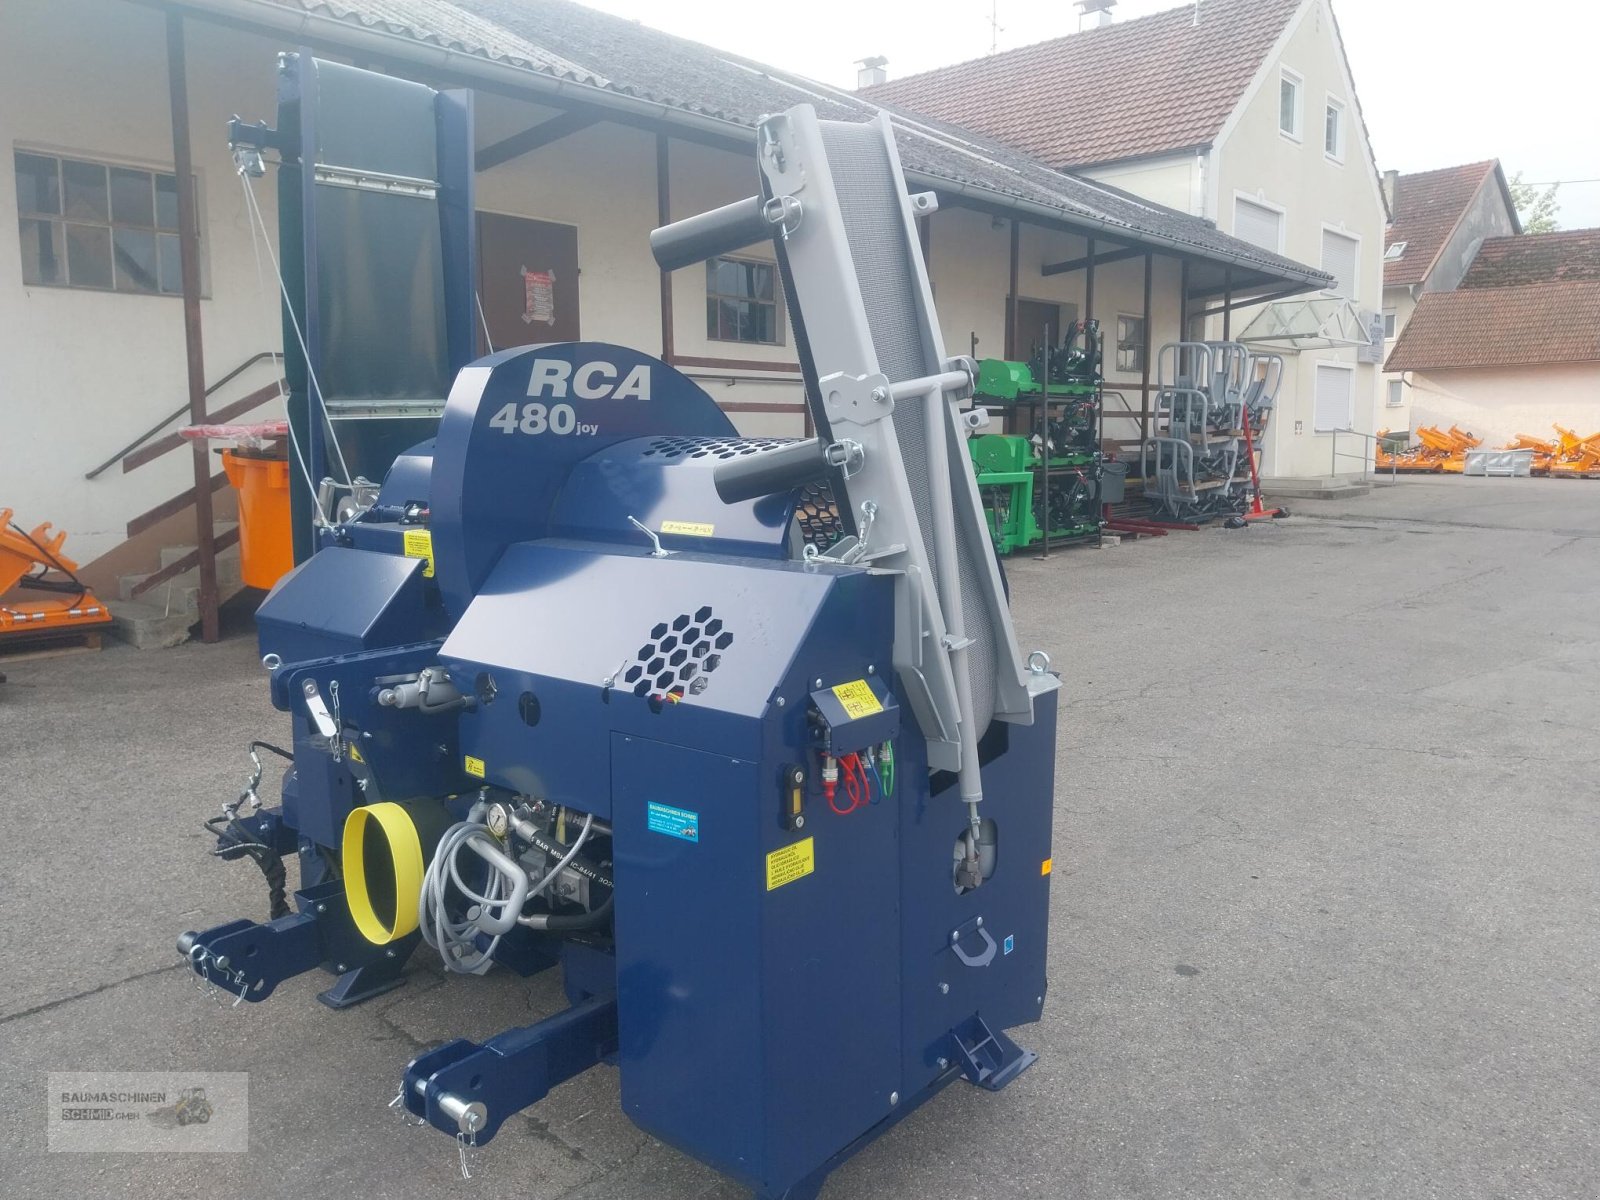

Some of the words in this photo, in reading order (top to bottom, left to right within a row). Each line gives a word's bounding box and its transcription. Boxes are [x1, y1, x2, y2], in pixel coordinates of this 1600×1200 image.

[527, 358, 651, 401] RCA
[489, 403, 576, 435] 480
[576, 422, 599, 436] joy
[535, 839, 549, 851] BAR
